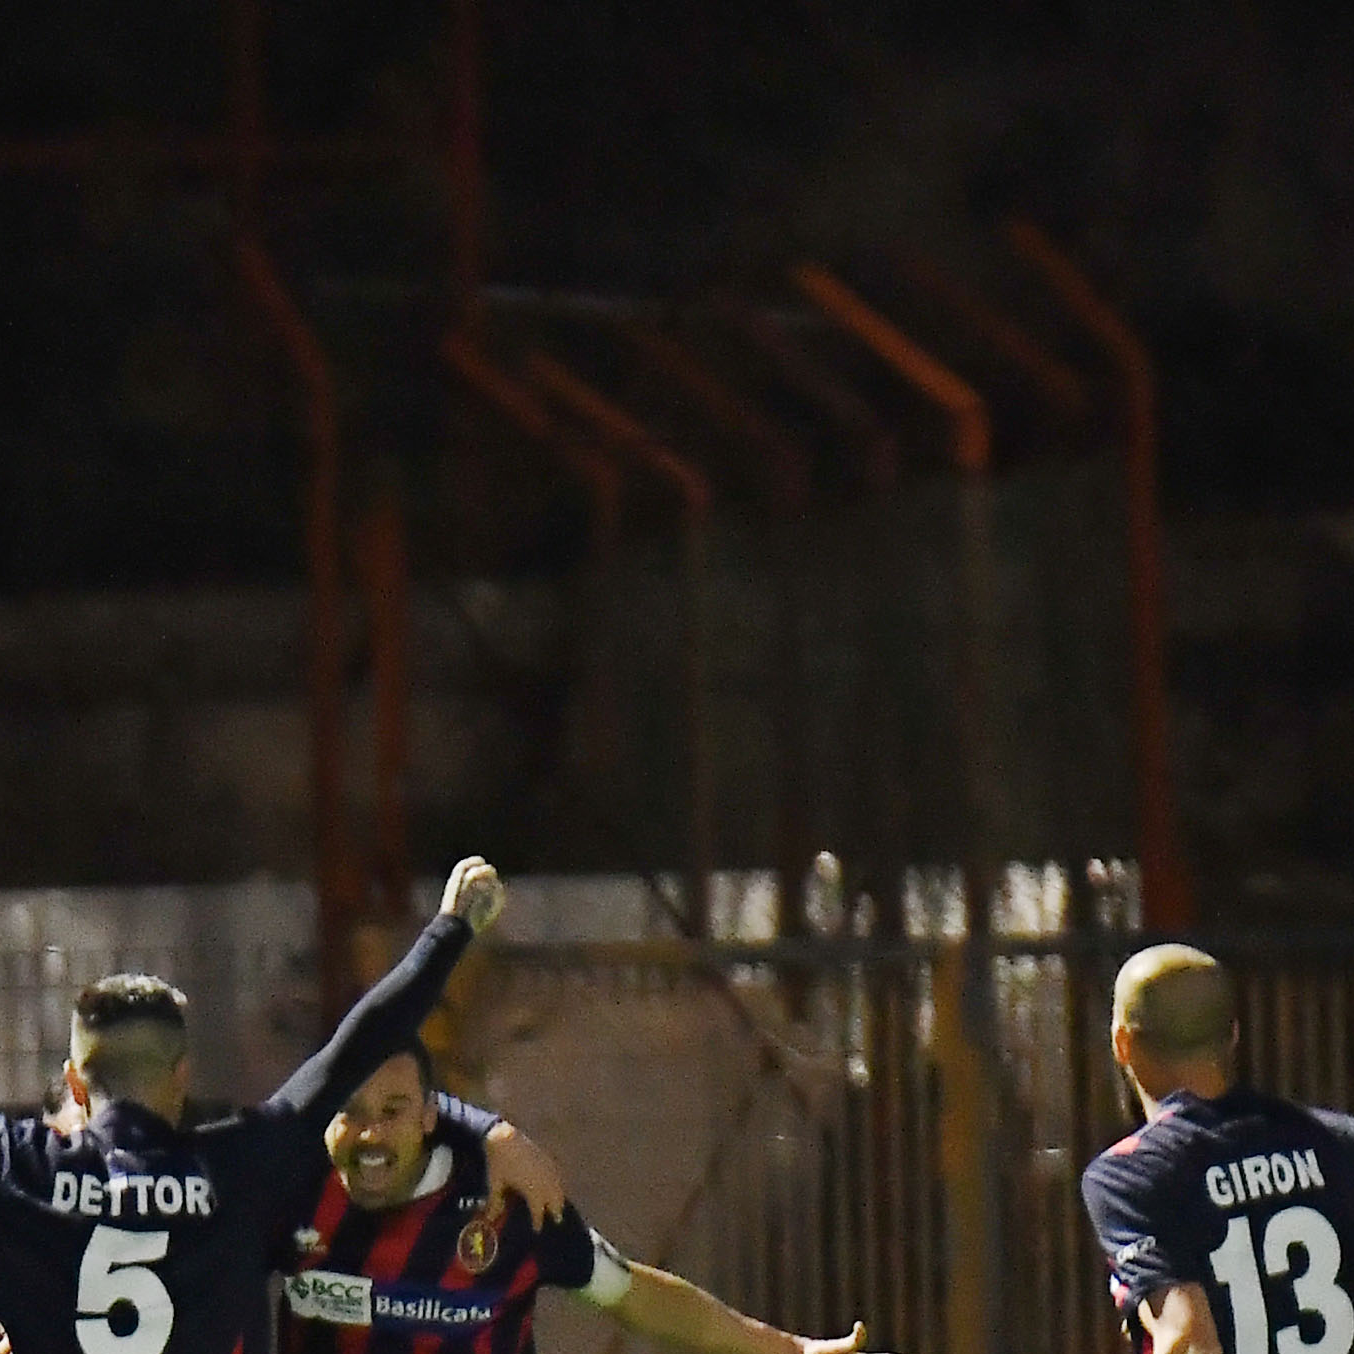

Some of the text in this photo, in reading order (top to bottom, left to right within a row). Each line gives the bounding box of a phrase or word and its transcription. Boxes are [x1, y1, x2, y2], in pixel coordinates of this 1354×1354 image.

[1206, 1148, 1325, 1208] GIRON
[312, 1278, 364, 1298] BCC
[375, 1296, 492, 1324] Basilicata
